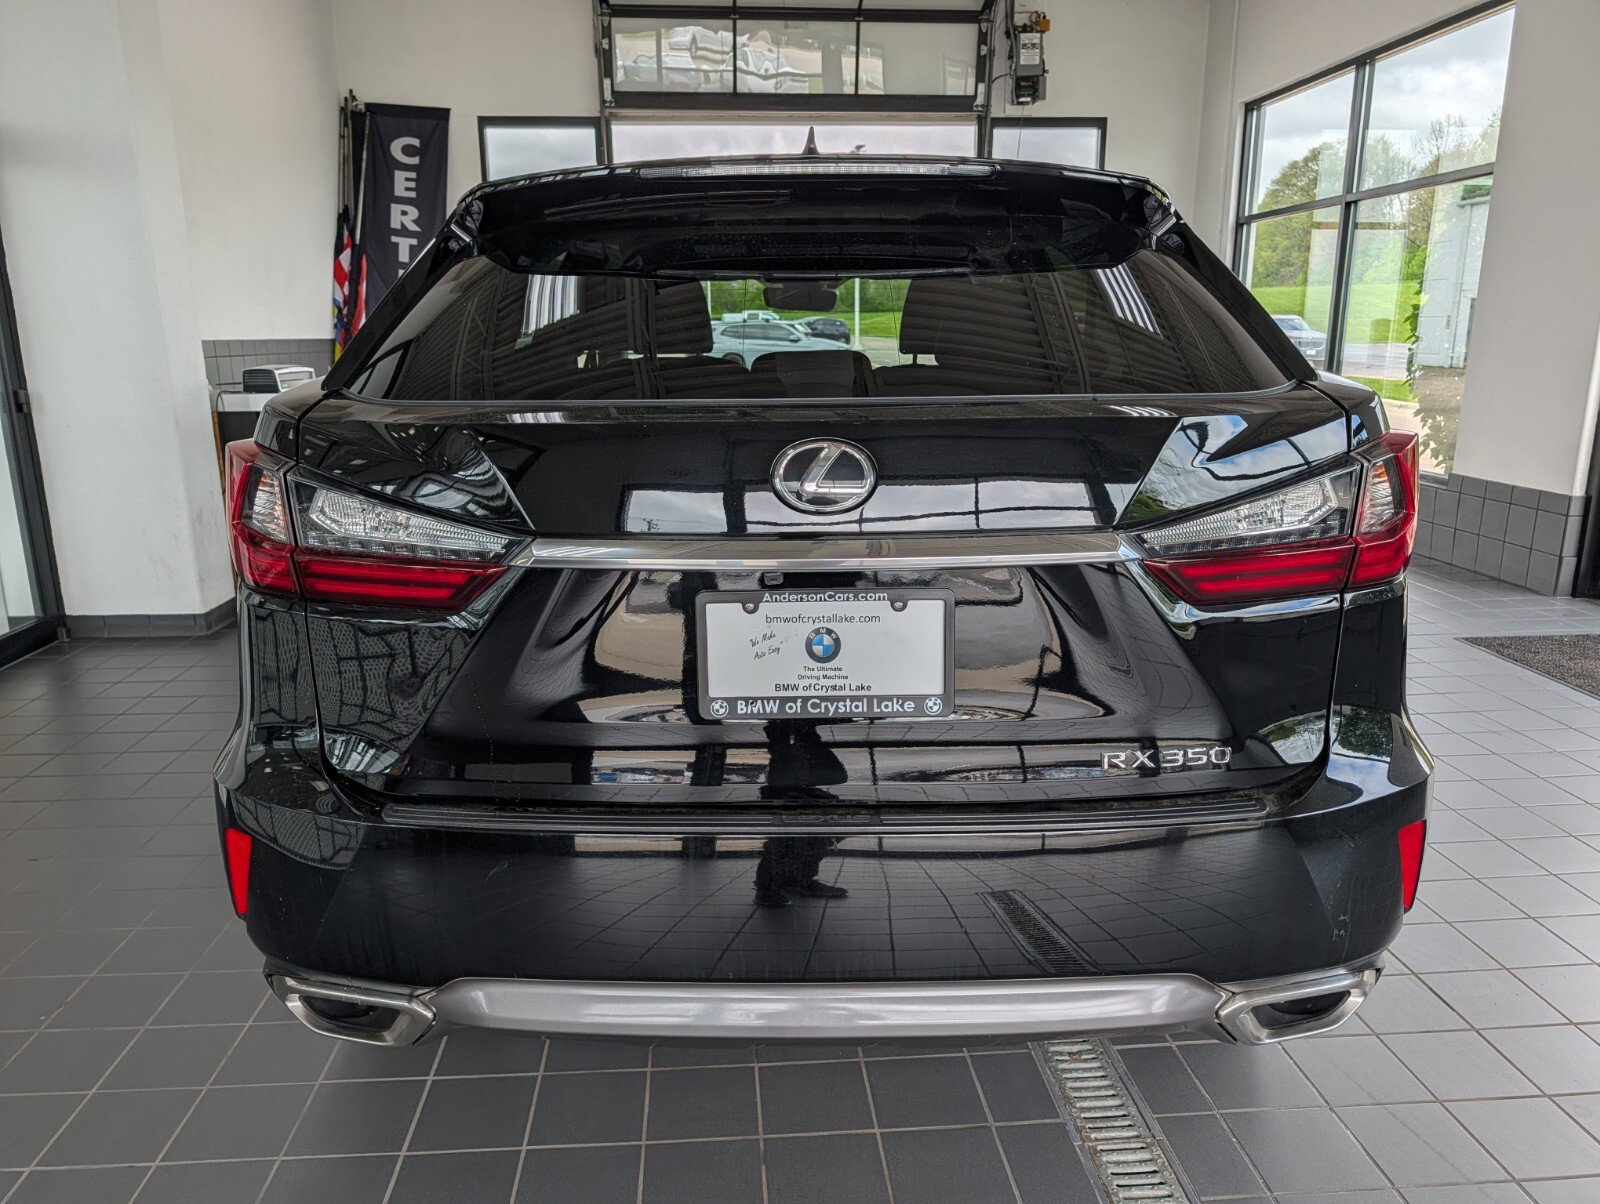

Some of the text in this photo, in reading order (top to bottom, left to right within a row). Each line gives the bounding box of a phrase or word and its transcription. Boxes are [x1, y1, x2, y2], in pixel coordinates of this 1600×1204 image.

[762, 591, 888, 602] AndersonCars.com
[765, 613, 881, 625] bmwofcrystallake.com
[774, 683, 872, 693] BMW of Crystal Lake
[737, 697, 916, 716] BMW of Crystal Lake
[1102, 746, 1232, 769] RX 350
